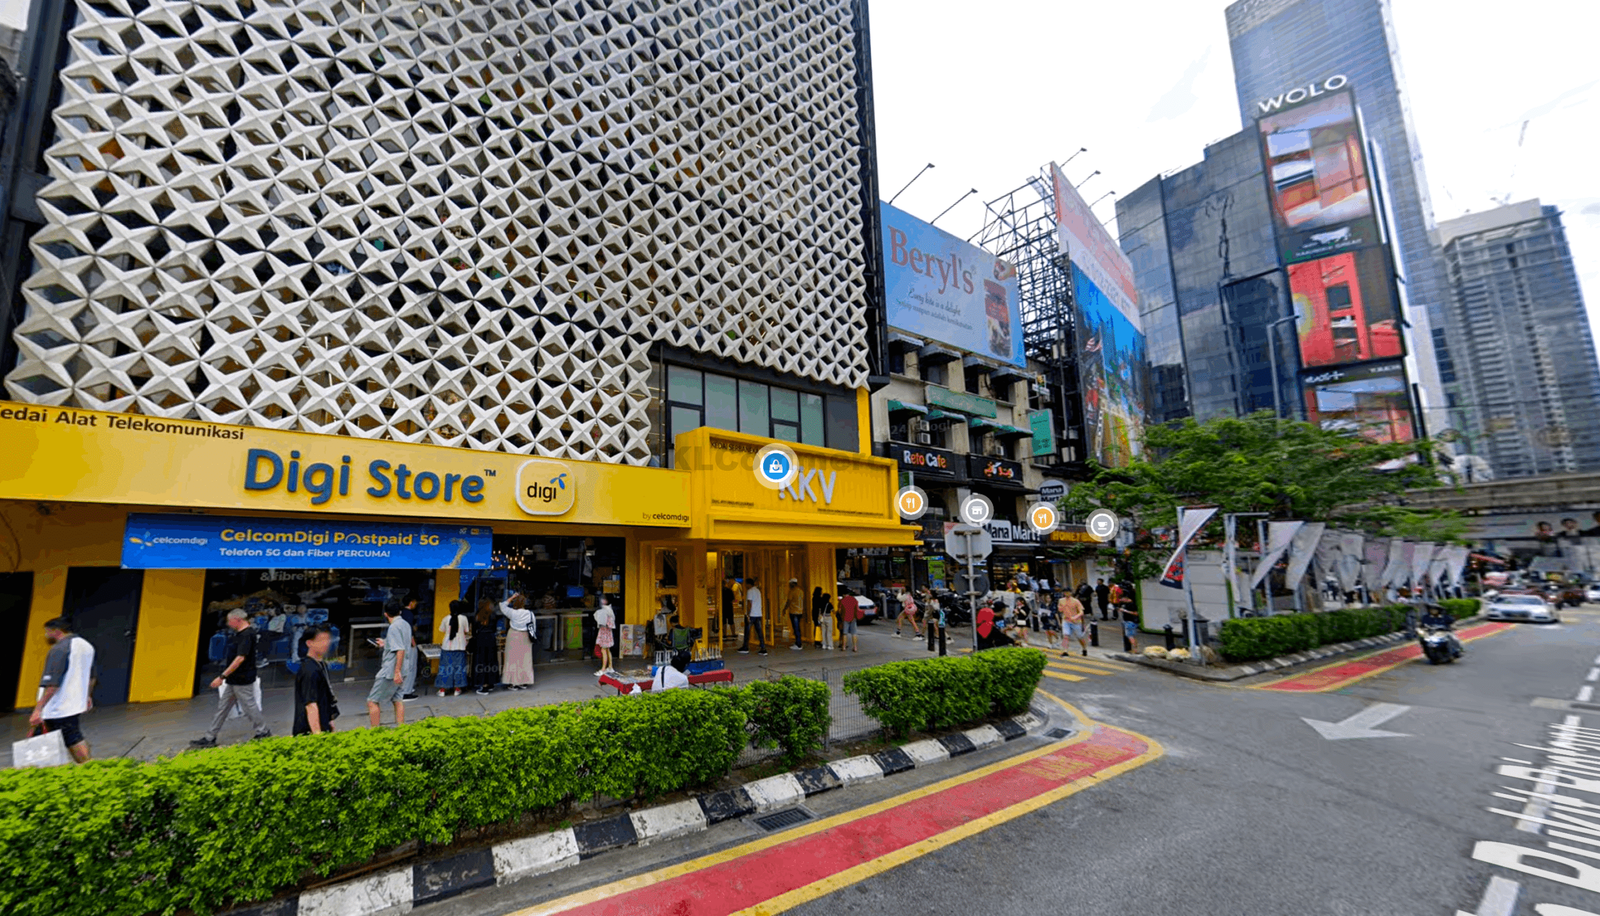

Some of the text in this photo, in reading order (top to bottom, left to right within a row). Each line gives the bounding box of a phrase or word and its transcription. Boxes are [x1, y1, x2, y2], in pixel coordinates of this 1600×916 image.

[1258, 75, 1347, 113] WOLO
[888, 225, 974, 295] Beryl's
[55, 410, 97, 427] Alat
[106, 414, 244, 440] Telekomunikasi
[903, 450, 947, 469] Reto Cafe
[244, 448, 351, 505] Digi
[527, 482, 557, 502] digi
[1042, 486, 1063, 495] Mana
[642, 512, 652, 521] by
[220, 529, 329, 547] CelcomDigi
[419, 534, 440, 547] 5G
[982, 523, 1010, 539] Mana
[219, 548, 391, 559] Telefon 5G dan Fiber PERCUMA!
